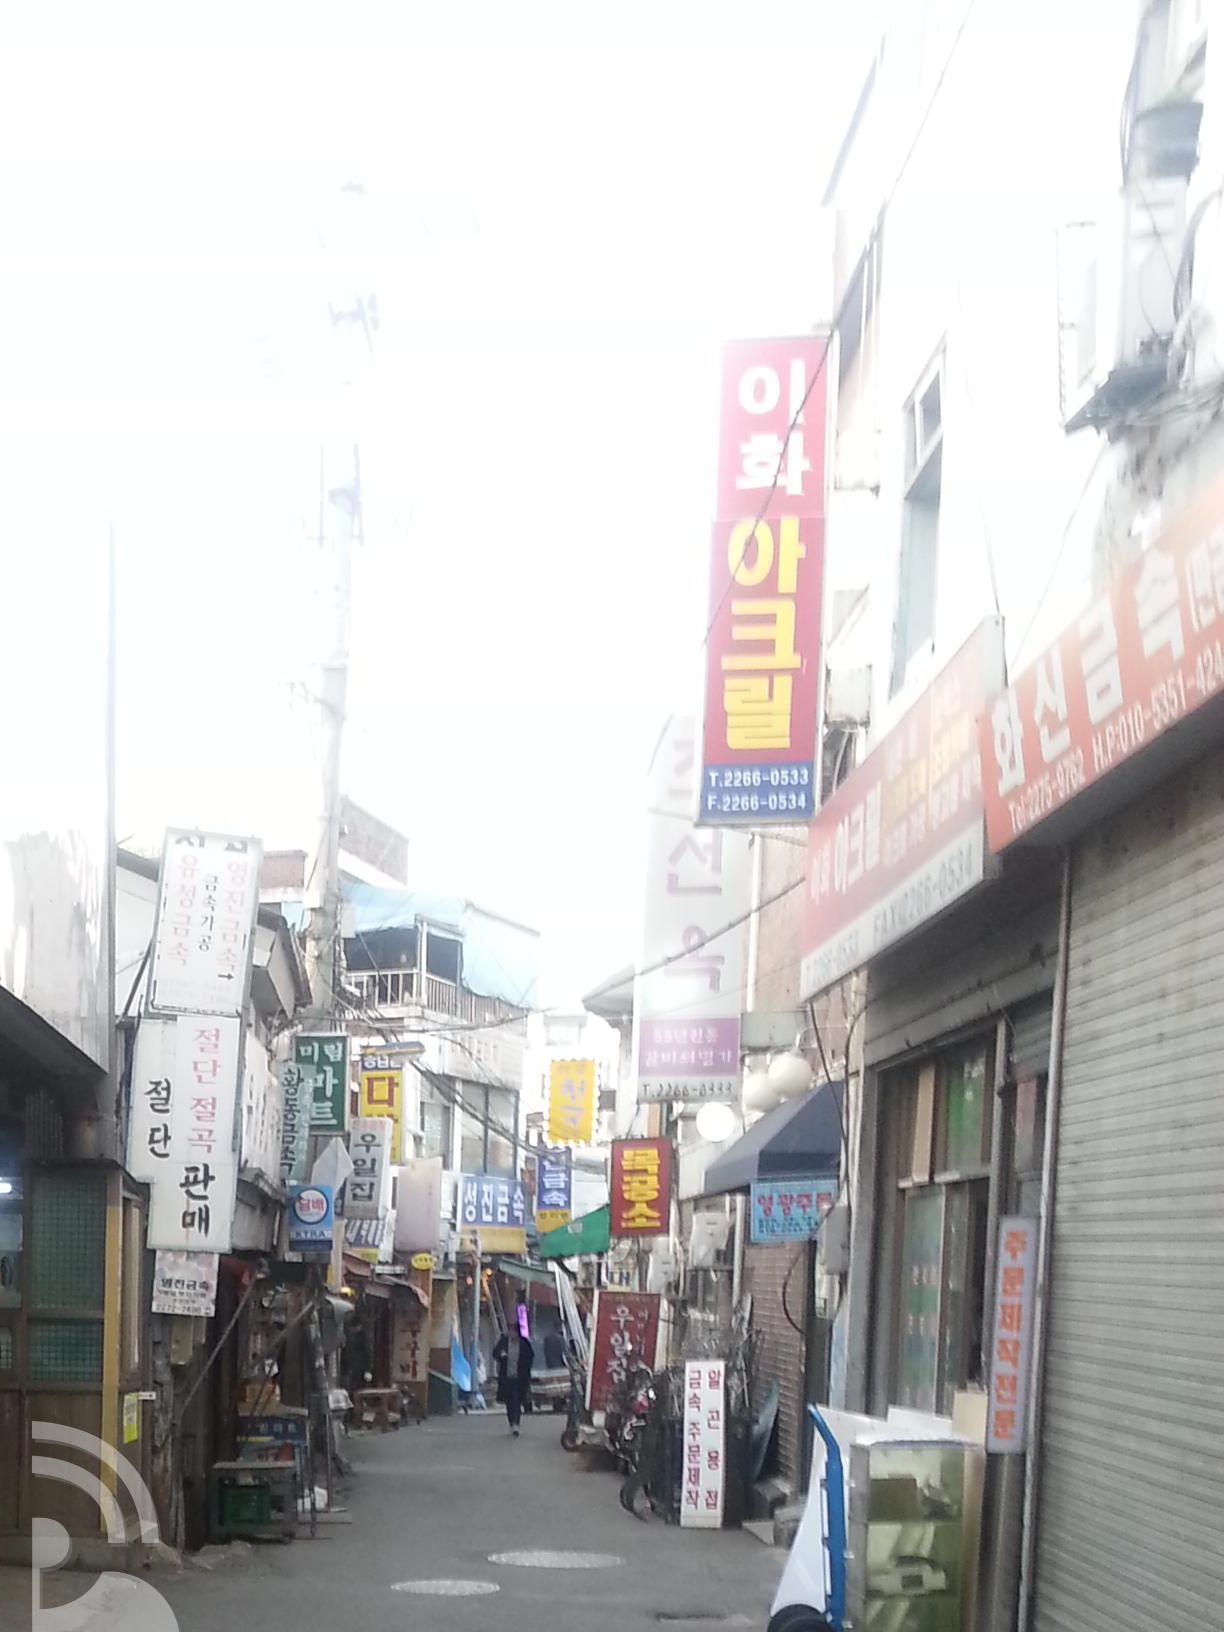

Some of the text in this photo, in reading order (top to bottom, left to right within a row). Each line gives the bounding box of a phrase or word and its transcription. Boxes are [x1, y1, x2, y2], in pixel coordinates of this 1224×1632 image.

[721, 357, 811, 751] 이화 아크릴
[990, 549, 1185, 798] 화신금속
[707, 791, 807, 812] F.2266-0534
[709, 767, 809, 788] T.2266-0533
[193, 1027, 221, 1085] 절단
[143, 1077, 173, 1160] 절단
[187, 1097, 218, 1155] 절곡
[309, 1065, 340, 1126] 마트
[179, 1163, 216, 1238] 판매
[350, 1132, 382, 1203] 우일집
[464, 1181, 525, 1225] 성진금속
[621, 1148, 661, 1229] 목공소
[685, 1369, 702, 1511] 금속 주문제작
